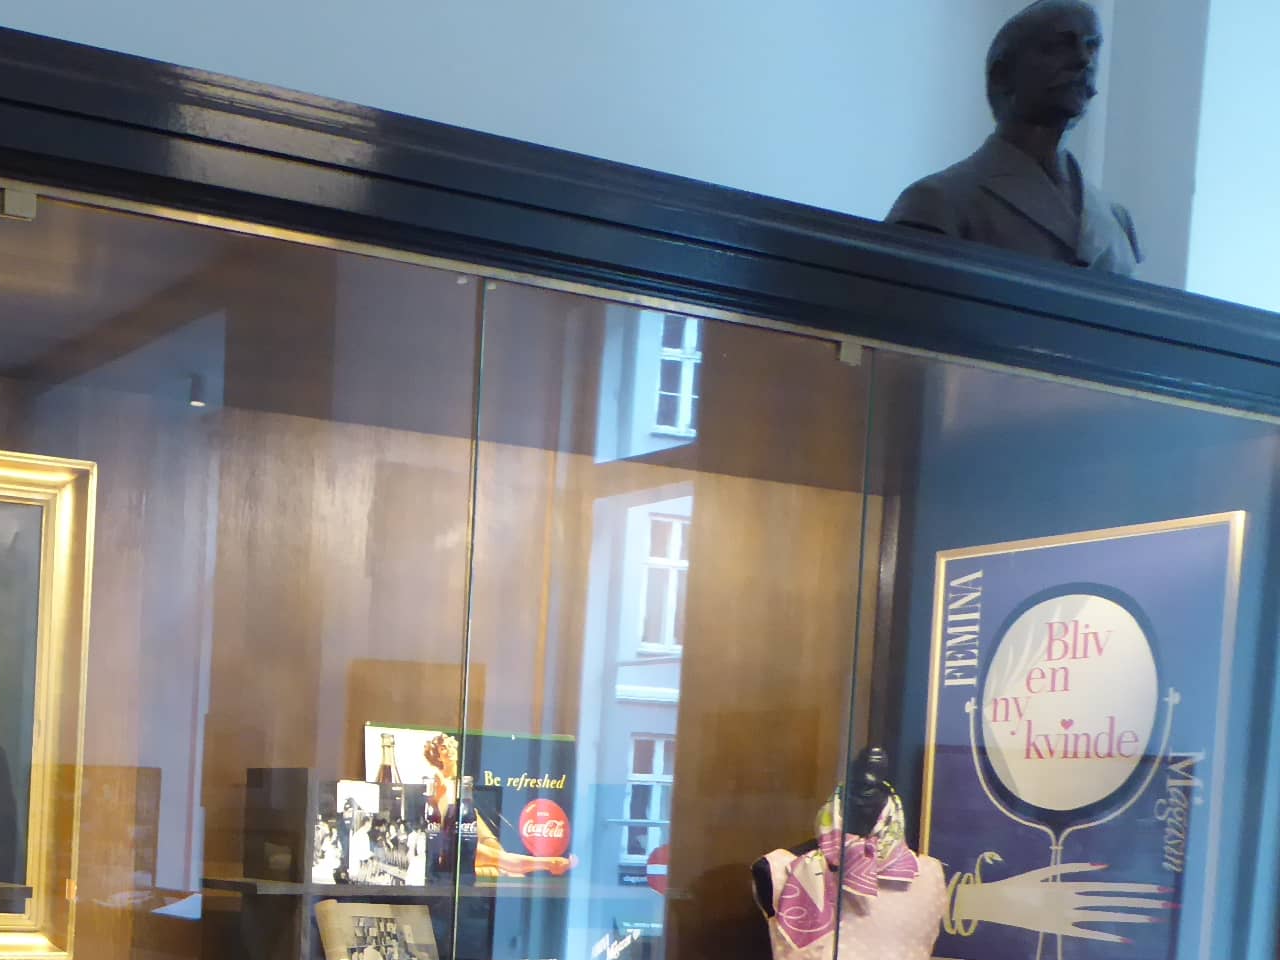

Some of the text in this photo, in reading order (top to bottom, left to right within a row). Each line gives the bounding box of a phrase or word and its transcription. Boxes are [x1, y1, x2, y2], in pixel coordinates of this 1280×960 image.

[944, 570, 983, 687] FEMINA
[1044, 620, 1116, 662] Bliv
[1026, 665, 1071, 694] en
[991, 696, 1031, 736] ny
[1023, 716, 1140, 760] kvinde
[484, 770, 567, 791] Be refreshed
[522, 819, 565, 839] Coca-Cola
[1154, 748, 1206, 873] Magasin
